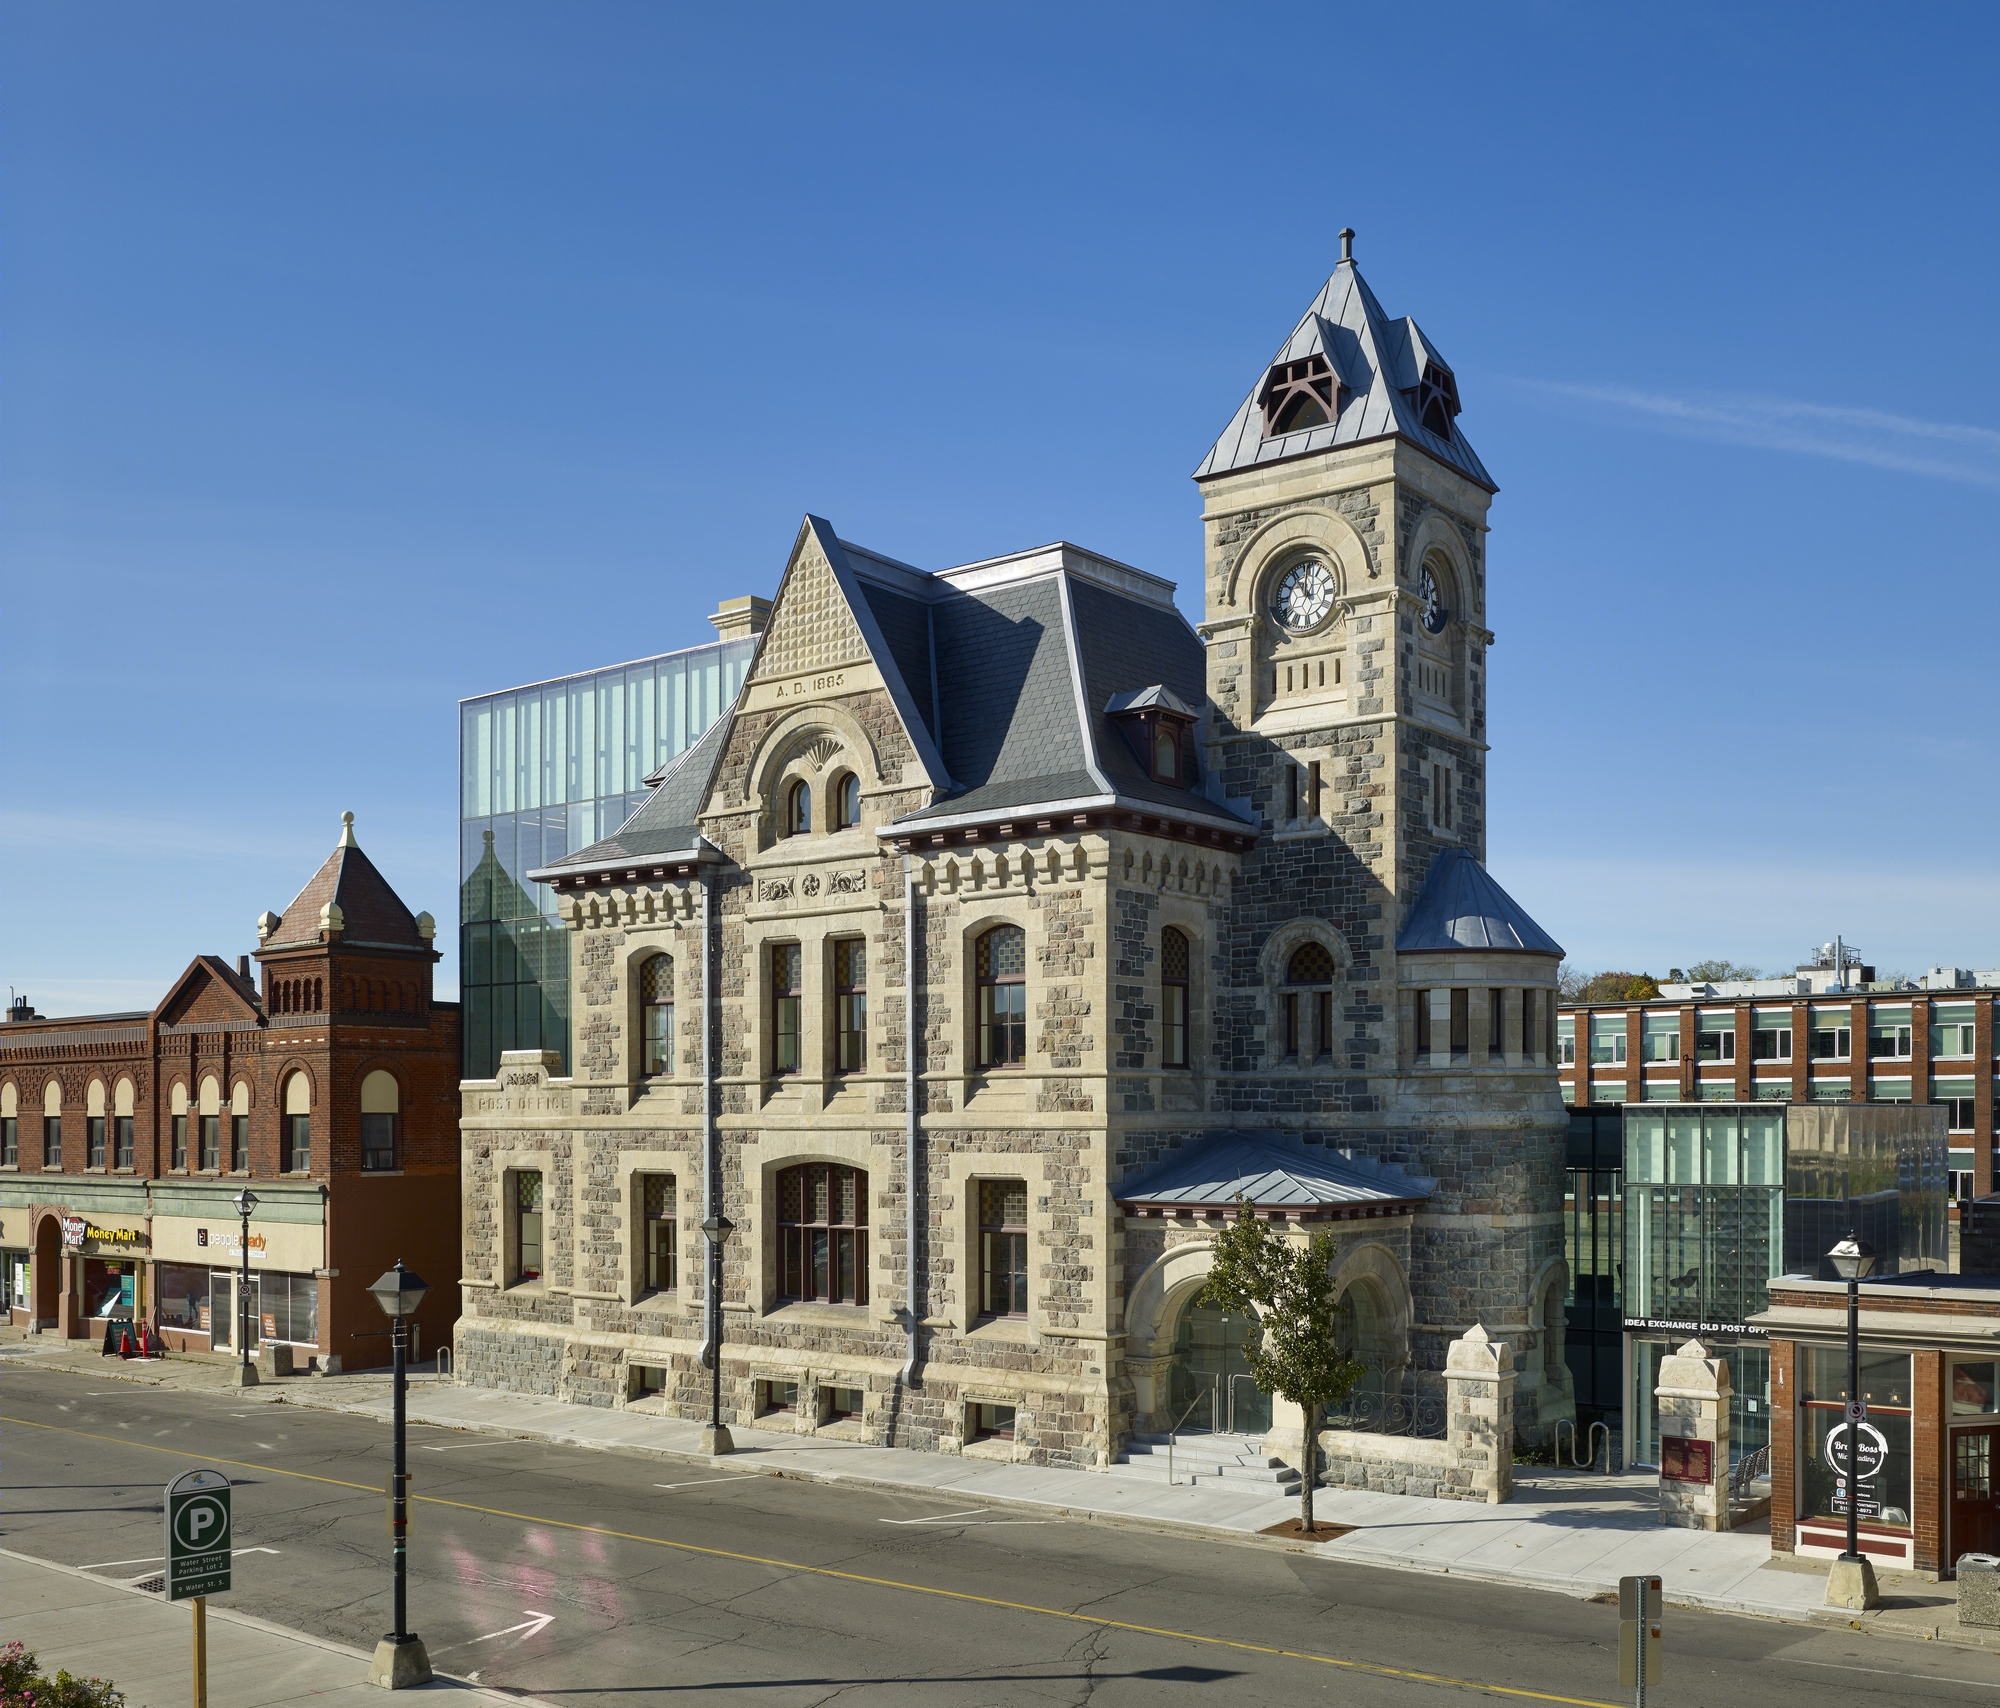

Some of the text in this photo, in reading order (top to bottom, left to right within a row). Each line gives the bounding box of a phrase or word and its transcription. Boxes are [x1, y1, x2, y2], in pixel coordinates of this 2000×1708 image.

[478, 1096, 569, 1110] POST OFFICE
[62, 1217, 86, 1236] Money
[64, 1231, 83, 1246] Mart
[87, 1227, 136, 1243] Money Mart
[1625, 1319, 1767, 1334] IDEA EXCHANGE OLD POST OFF
[1858, 1443, 1878, 1453] Boss
[190, 1507, 215, 1541] P
[180, 1555, 222, 1567] Water Street
[178, 1566, 204, 1575] Parking
[185, 1583, 204, 1591] Water
